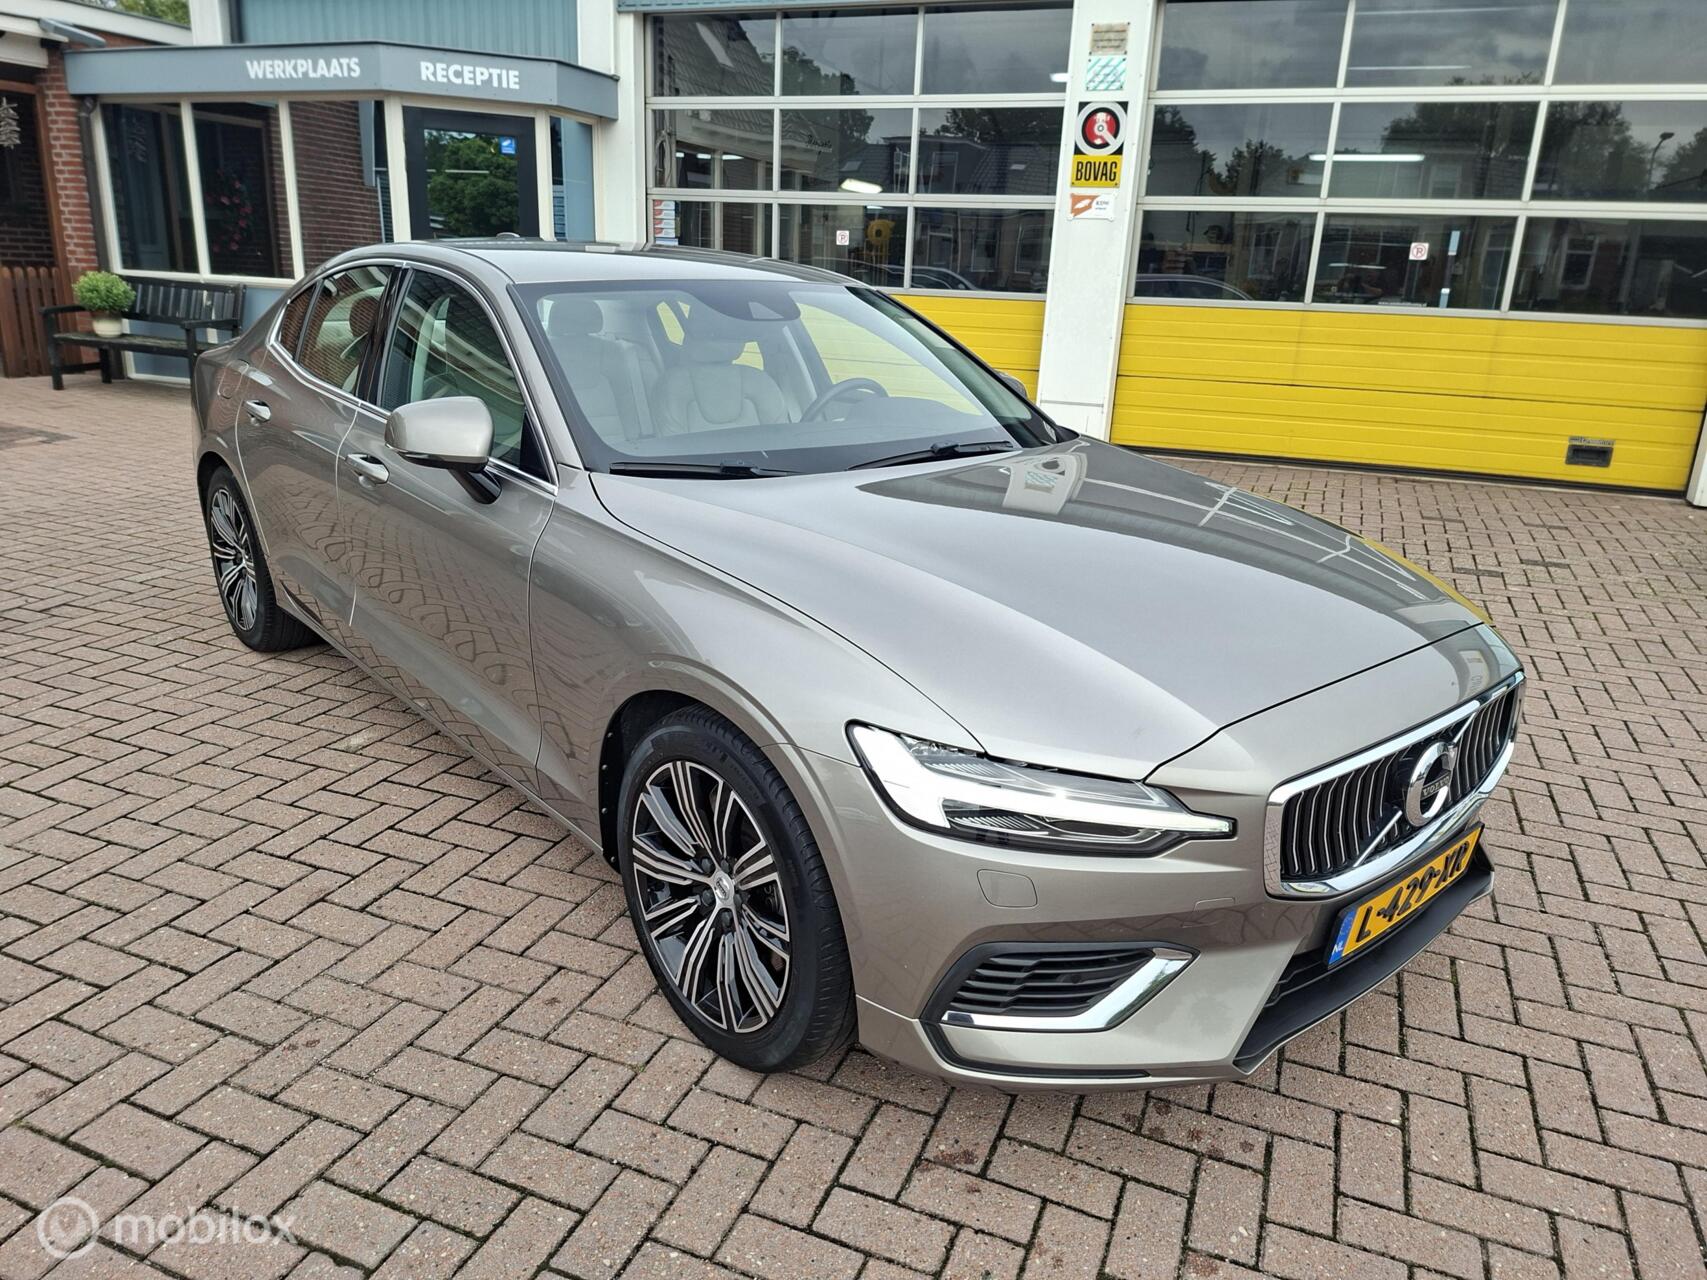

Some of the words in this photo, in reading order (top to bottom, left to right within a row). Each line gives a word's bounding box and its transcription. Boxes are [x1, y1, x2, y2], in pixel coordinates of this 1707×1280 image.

[246, 58, 361, 79] WERKPLAATS
[420, 61, 520, 90] RECEPTIE
[1075, 160, 1118, 182] BOVAG
[1356, 840, 1470, 943] L-429-XR
